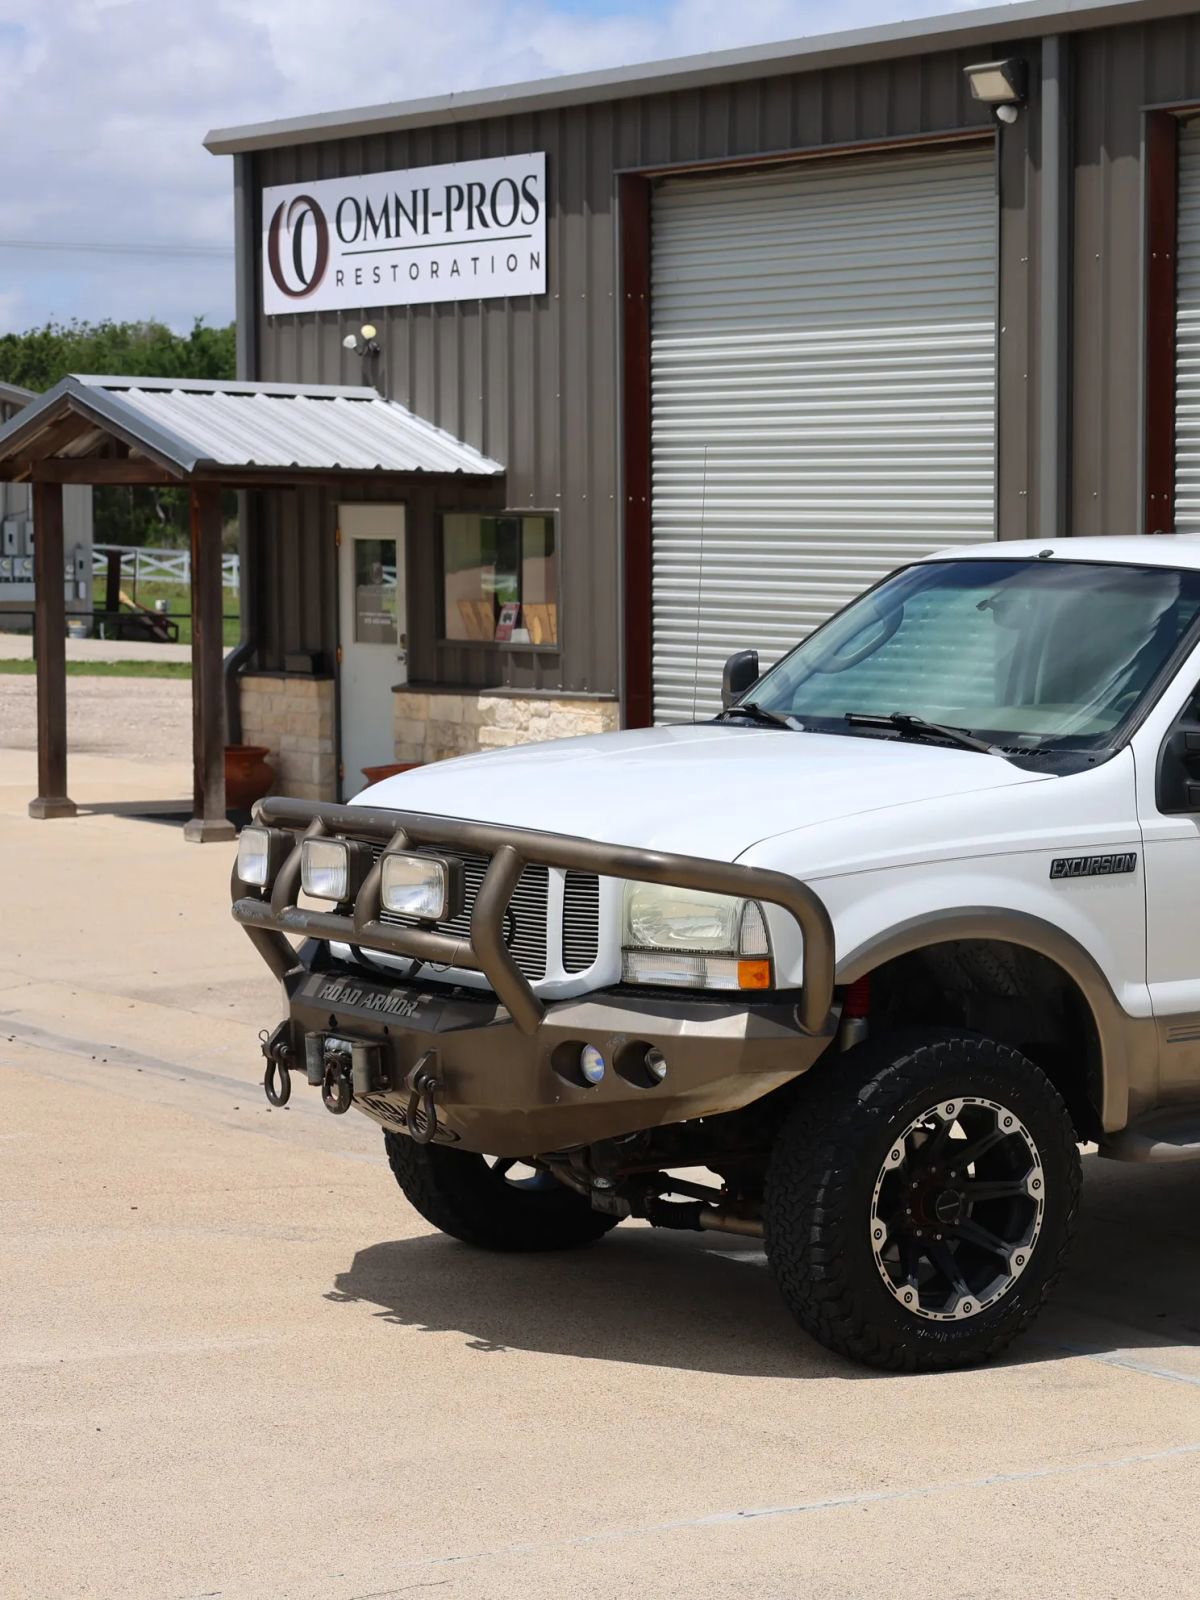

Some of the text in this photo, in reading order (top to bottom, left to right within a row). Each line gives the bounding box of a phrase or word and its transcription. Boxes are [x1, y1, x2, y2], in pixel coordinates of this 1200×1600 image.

[335, 174, 540, 244] OMNI-PROS
[335, 251, 541, 288] RESTORATION
[1050, 853, 1136, 878] EXCURSION
[318, 983, 419, 1017] ROAD ARMOR
